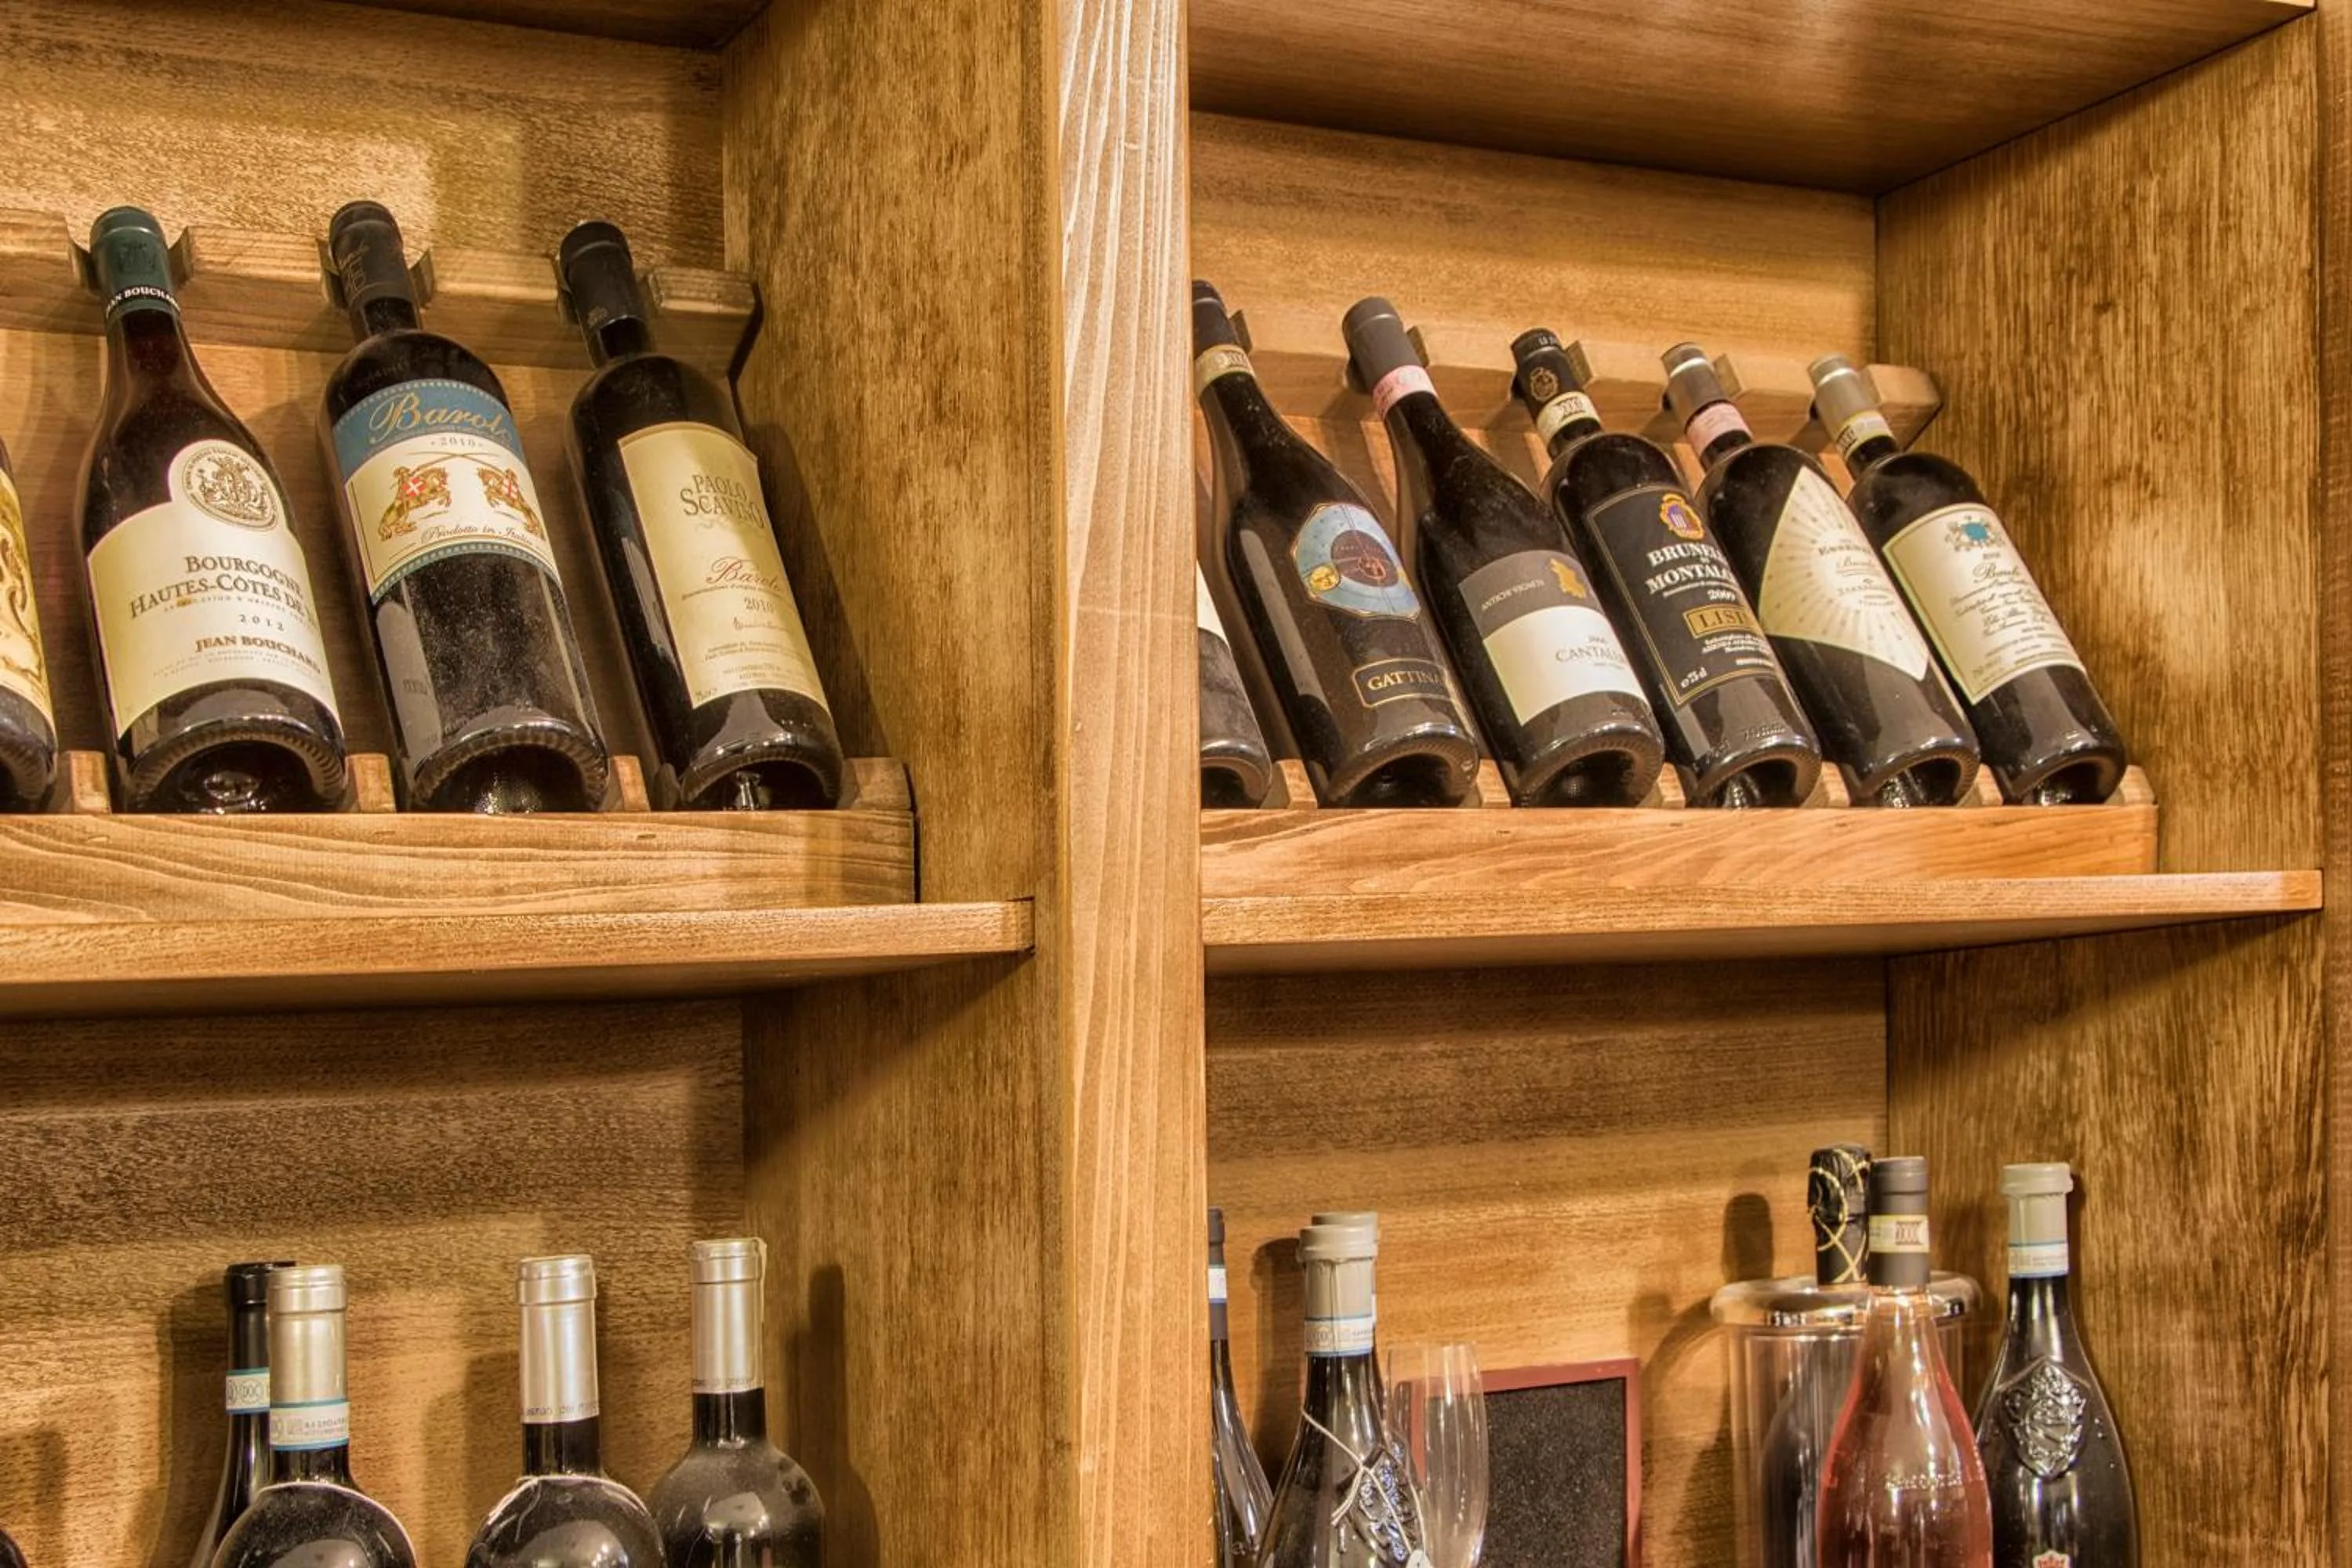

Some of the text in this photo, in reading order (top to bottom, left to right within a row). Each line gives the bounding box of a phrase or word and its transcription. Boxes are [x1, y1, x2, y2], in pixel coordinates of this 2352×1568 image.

[691, 474, 747, 503] PAOLO
[679, 488, 765, 530] SCAVINO
[183, 555, 304, 601] BOURGOGNE
[194, 634, 238, 653] JEAN
